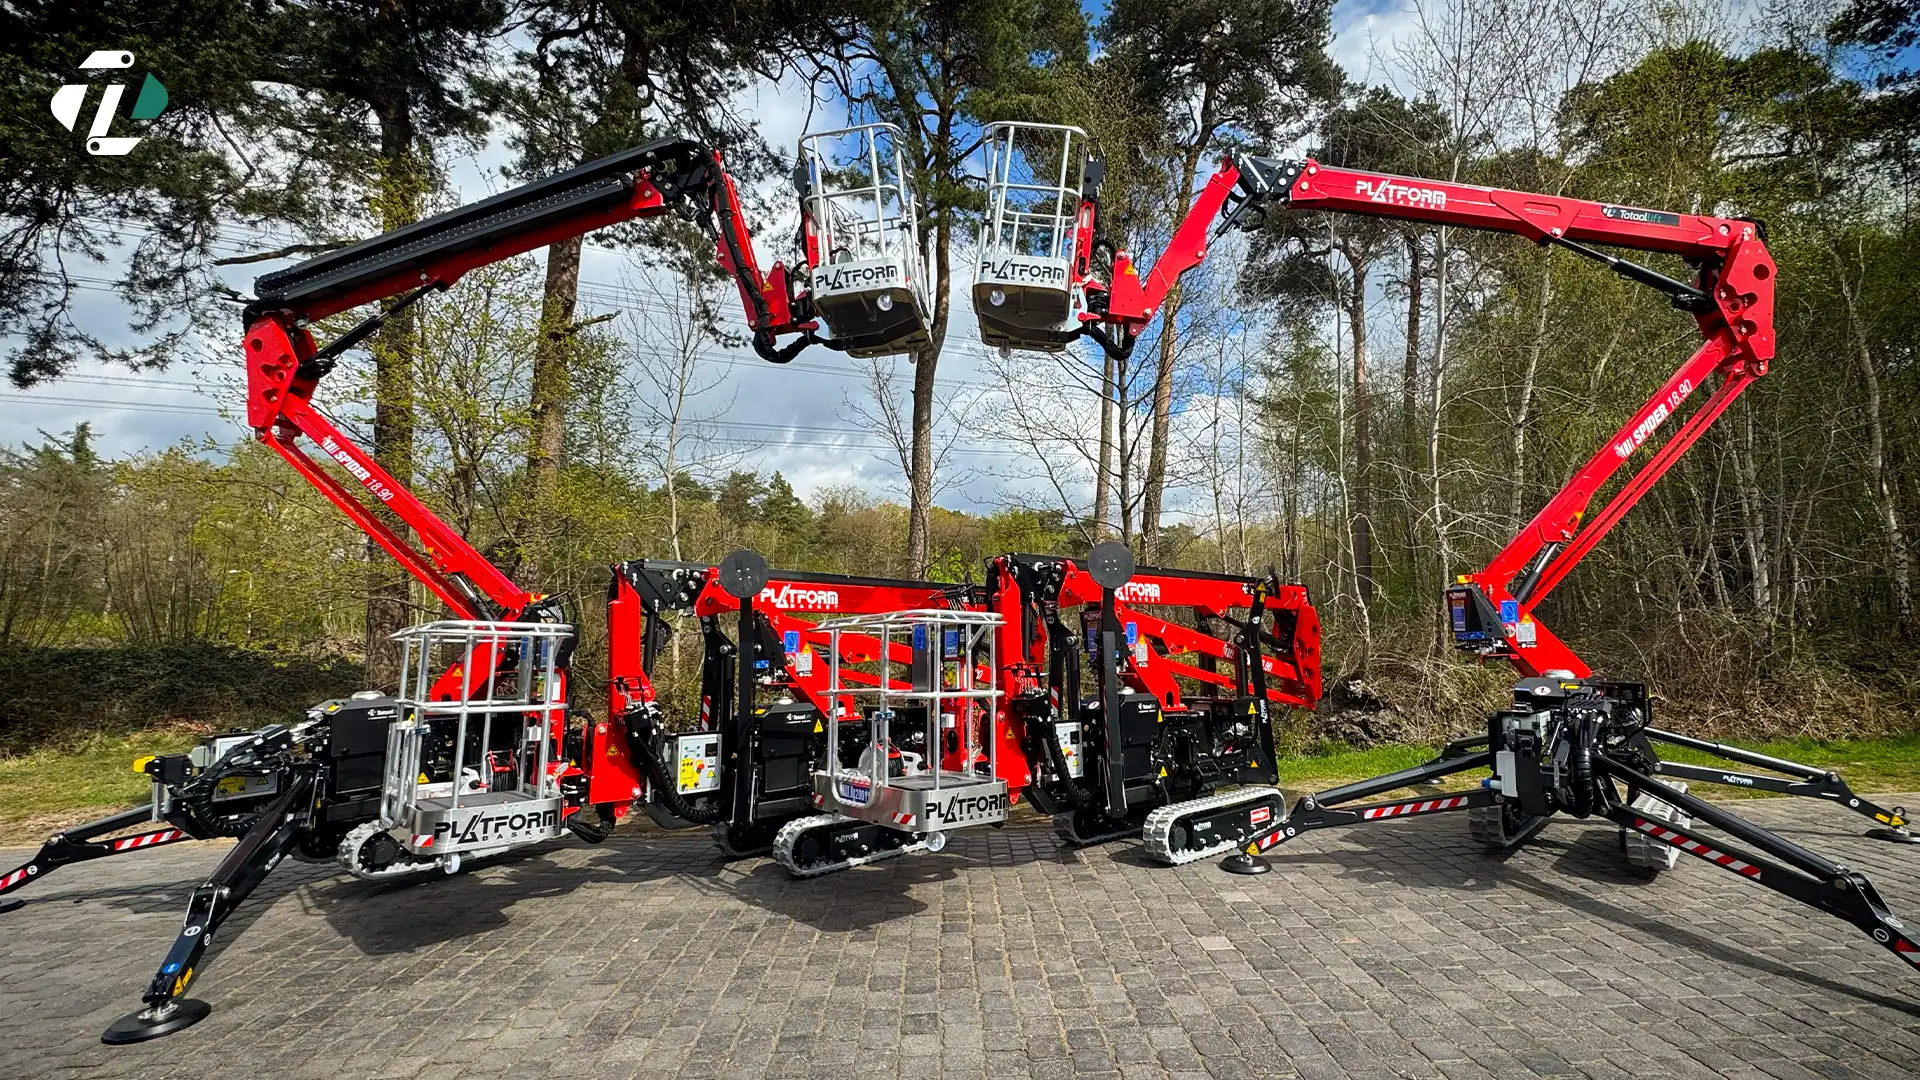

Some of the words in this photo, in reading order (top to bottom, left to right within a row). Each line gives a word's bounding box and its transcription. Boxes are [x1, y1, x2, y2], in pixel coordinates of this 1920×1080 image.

[1355, 179, 1447, 206] PLATFORM
[815, 265, 899, 291] PLATFORM
[980, 258, 1066, 281] PLATFORM
[1010, 276, 1064, 286] BASKET
[845, 278, 900, 289] BASKET
[1633, 403, 1669, 445] SPIDER
[1667, 378, 1692, 409] 18.90
[334, 450, 372, 482] SPIDER
[366, 478, 395, 501] 18.90
[760, 583, 839, 609] PLATFORM
[1114, 582, 1161, 601] ATFORM
[432, 810, 559, 845] PLATFORM
[482, 826, 557, 842] BASKET
